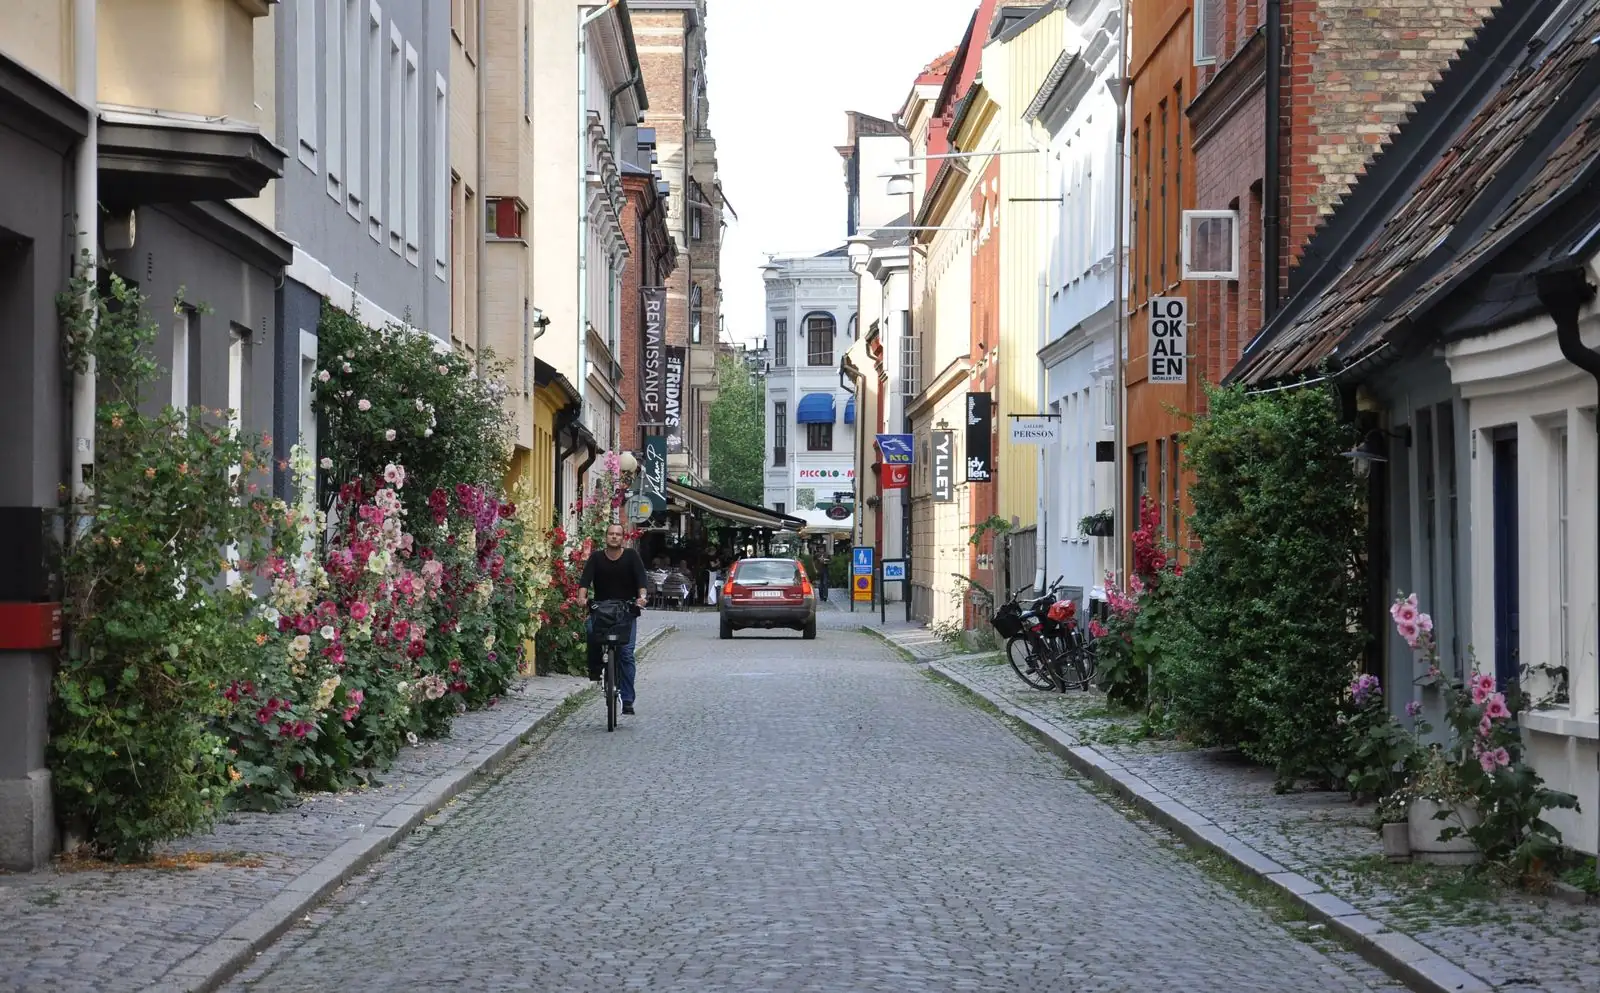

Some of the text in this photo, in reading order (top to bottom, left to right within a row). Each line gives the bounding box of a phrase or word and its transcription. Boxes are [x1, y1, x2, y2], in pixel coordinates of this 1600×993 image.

[1152, 301, 1183, 318] LO
[1152, 320, 1183, 337] OK
[645, 300, 660, 412] RENAISSANCE
[1152, 339, 1183, 356] AL
[1152, 358, 1183, 375] EN
[936, 434, 949, 500] YLLET
[967, 456, 984, 470] idy
